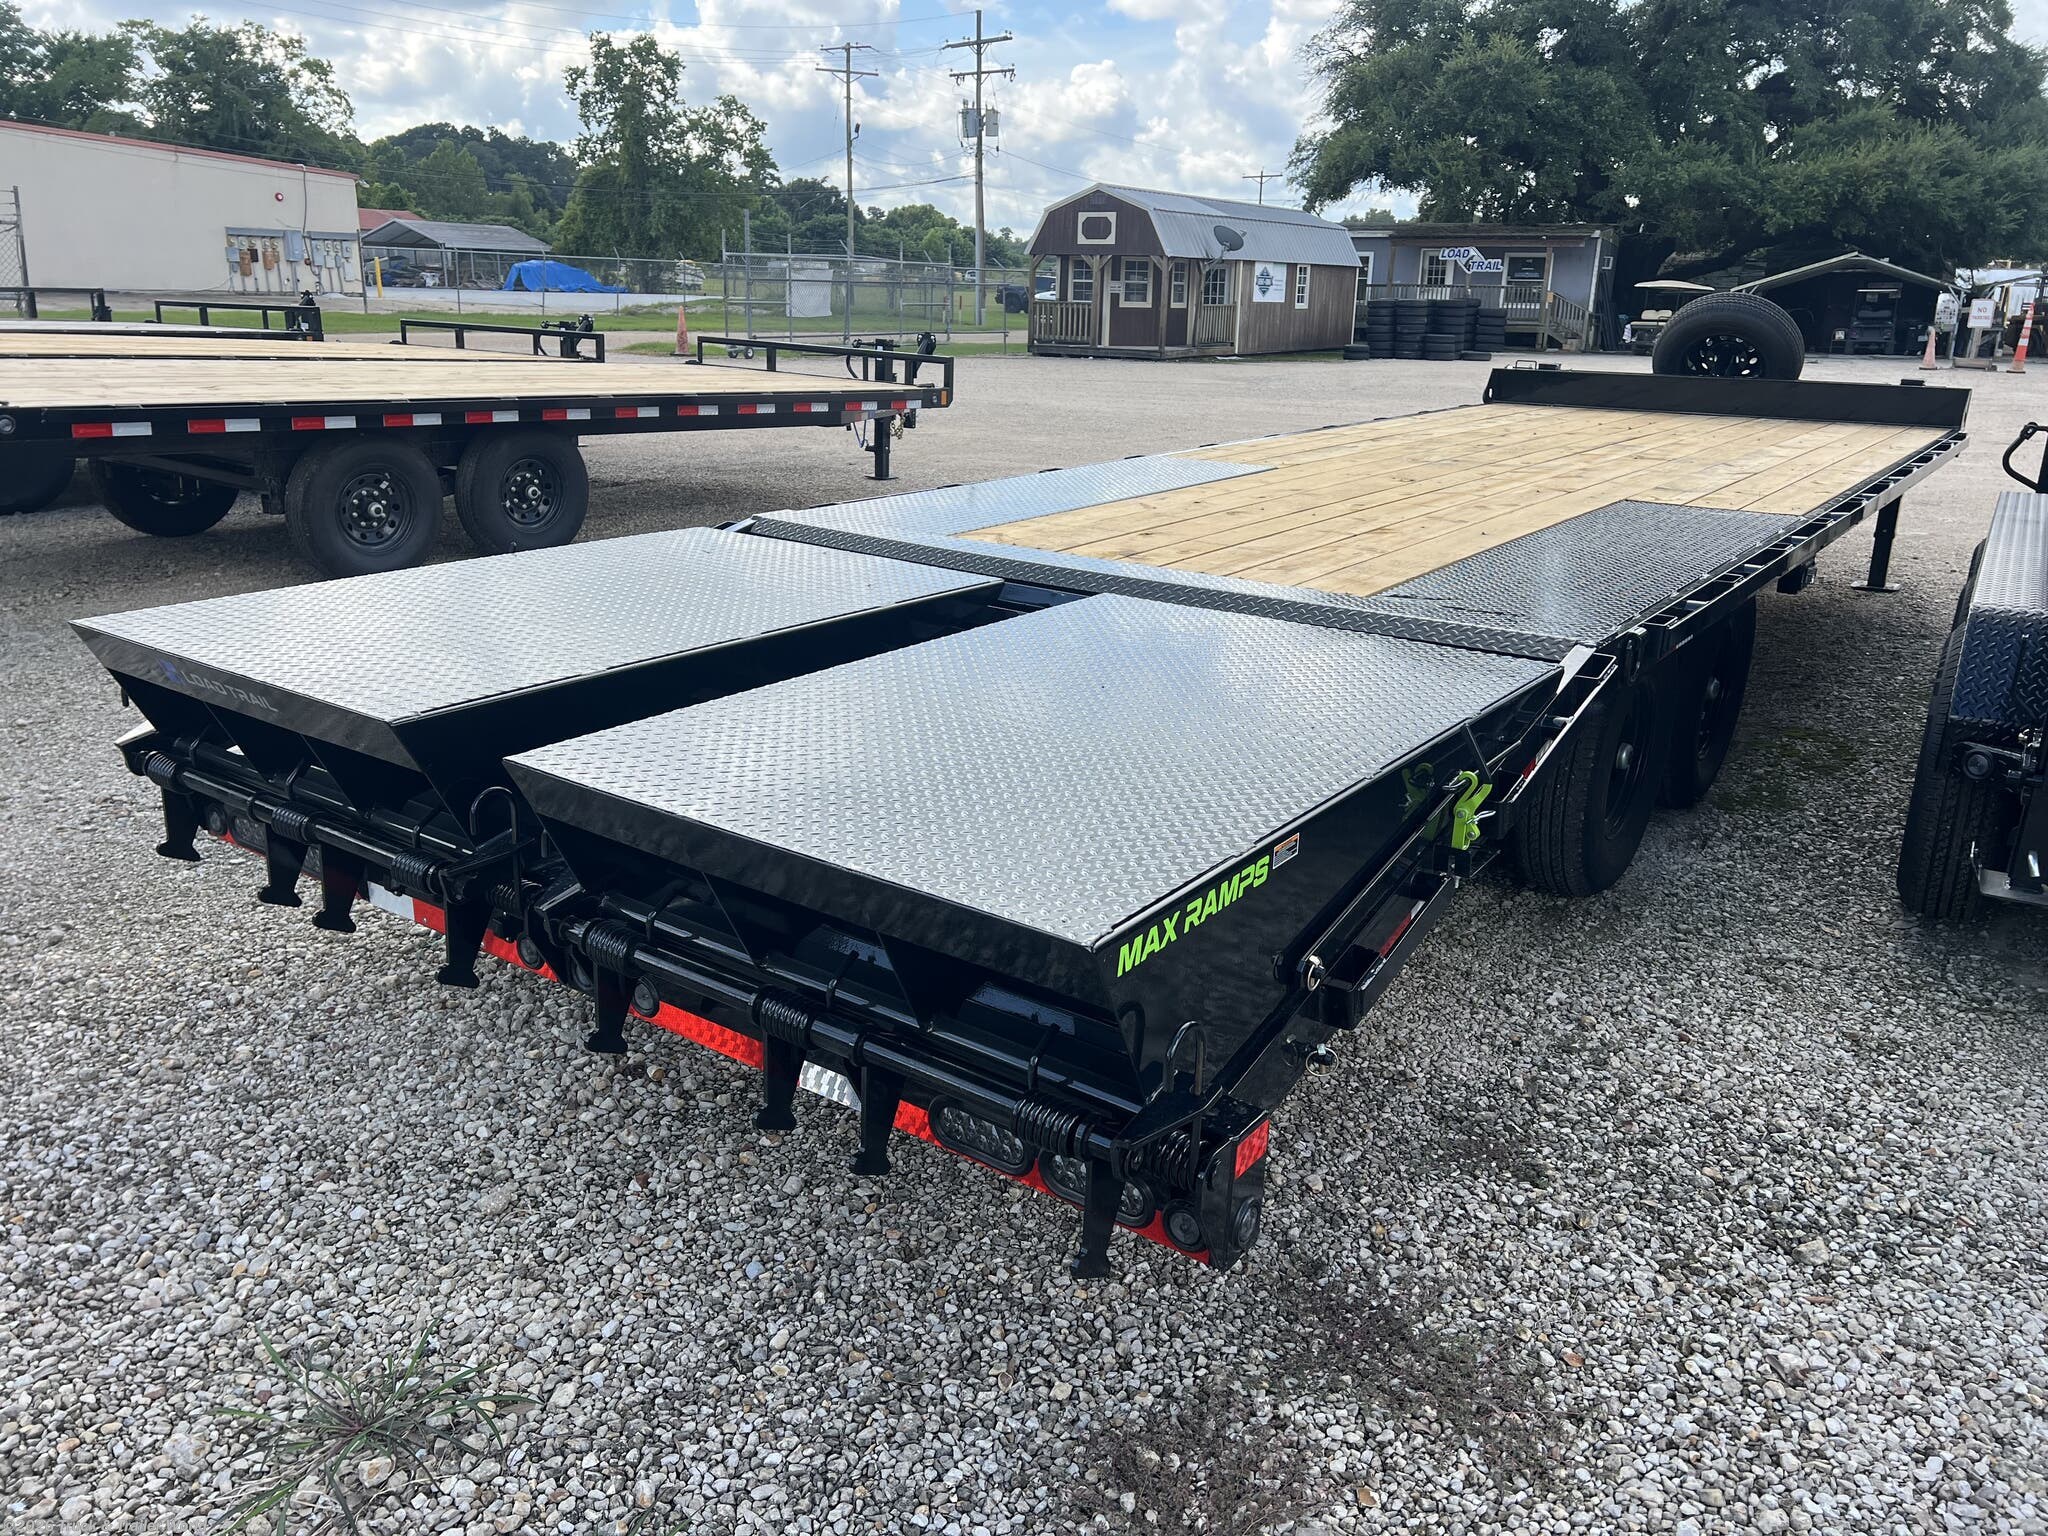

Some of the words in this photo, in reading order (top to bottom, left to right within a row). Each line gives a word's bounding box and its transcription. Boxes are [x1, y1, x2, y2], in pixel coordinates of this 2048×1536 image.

[1441, 249, 1470, 258] LOAD
[1471, 261, 1502, 270] TRAIL
[1117, 911, 1181, 978] MAX
[1184, 855, 1270, 934] RAMPS
